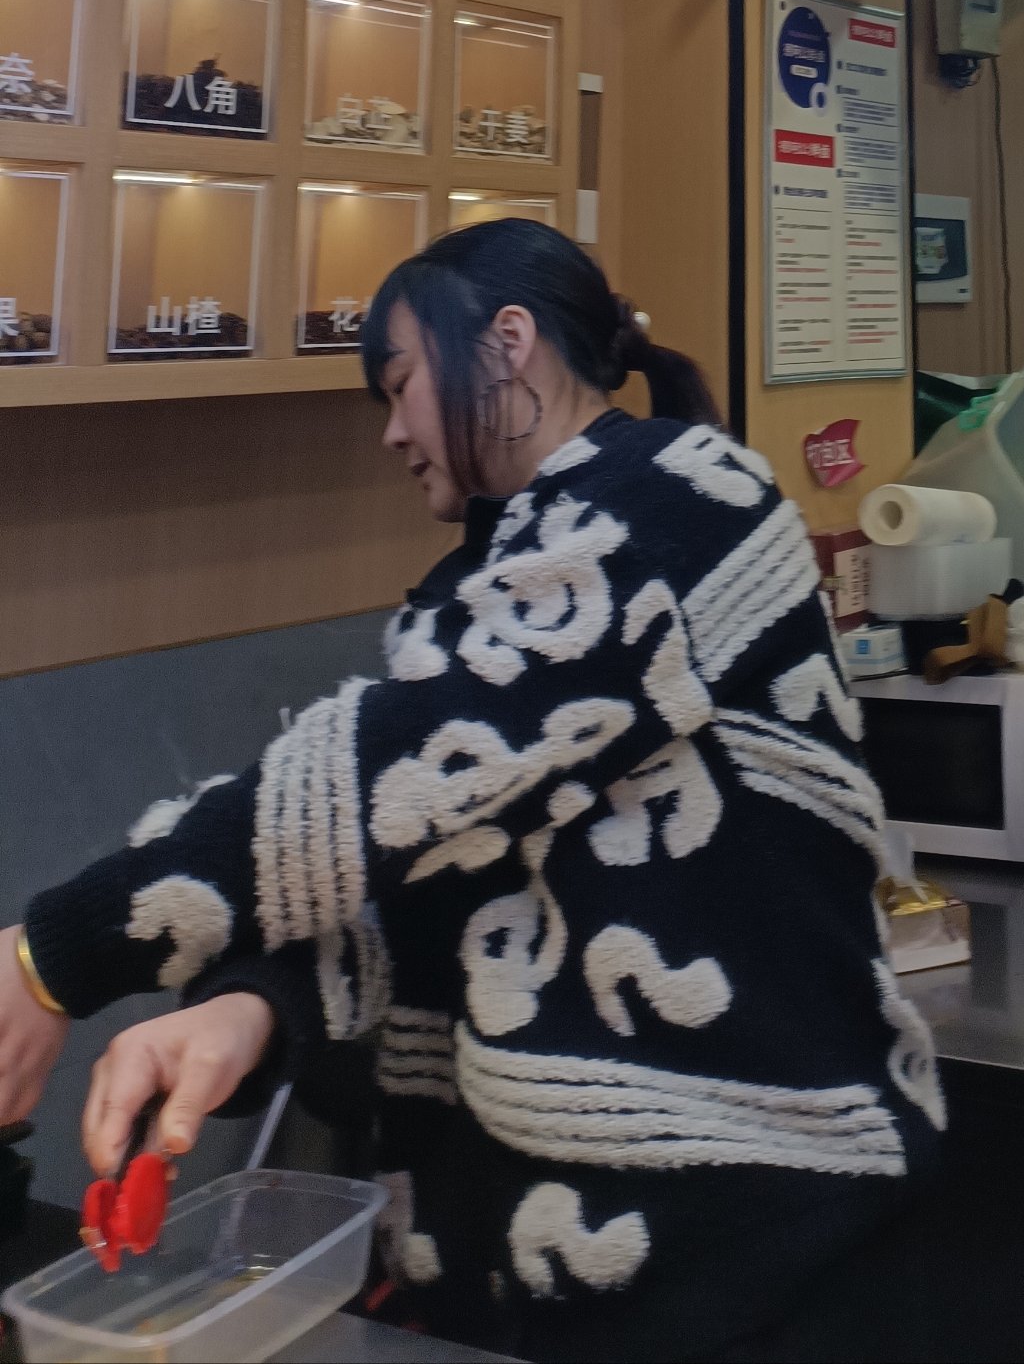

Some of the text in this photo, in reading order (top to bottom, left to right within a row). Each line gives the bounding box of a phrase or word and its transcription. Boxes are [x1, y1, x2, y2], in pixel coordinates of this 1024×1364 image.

[164, 74, 237, 115] 八角
[146, 296, 221, 336] 山楂
[330, 296, 373, 333] 花
